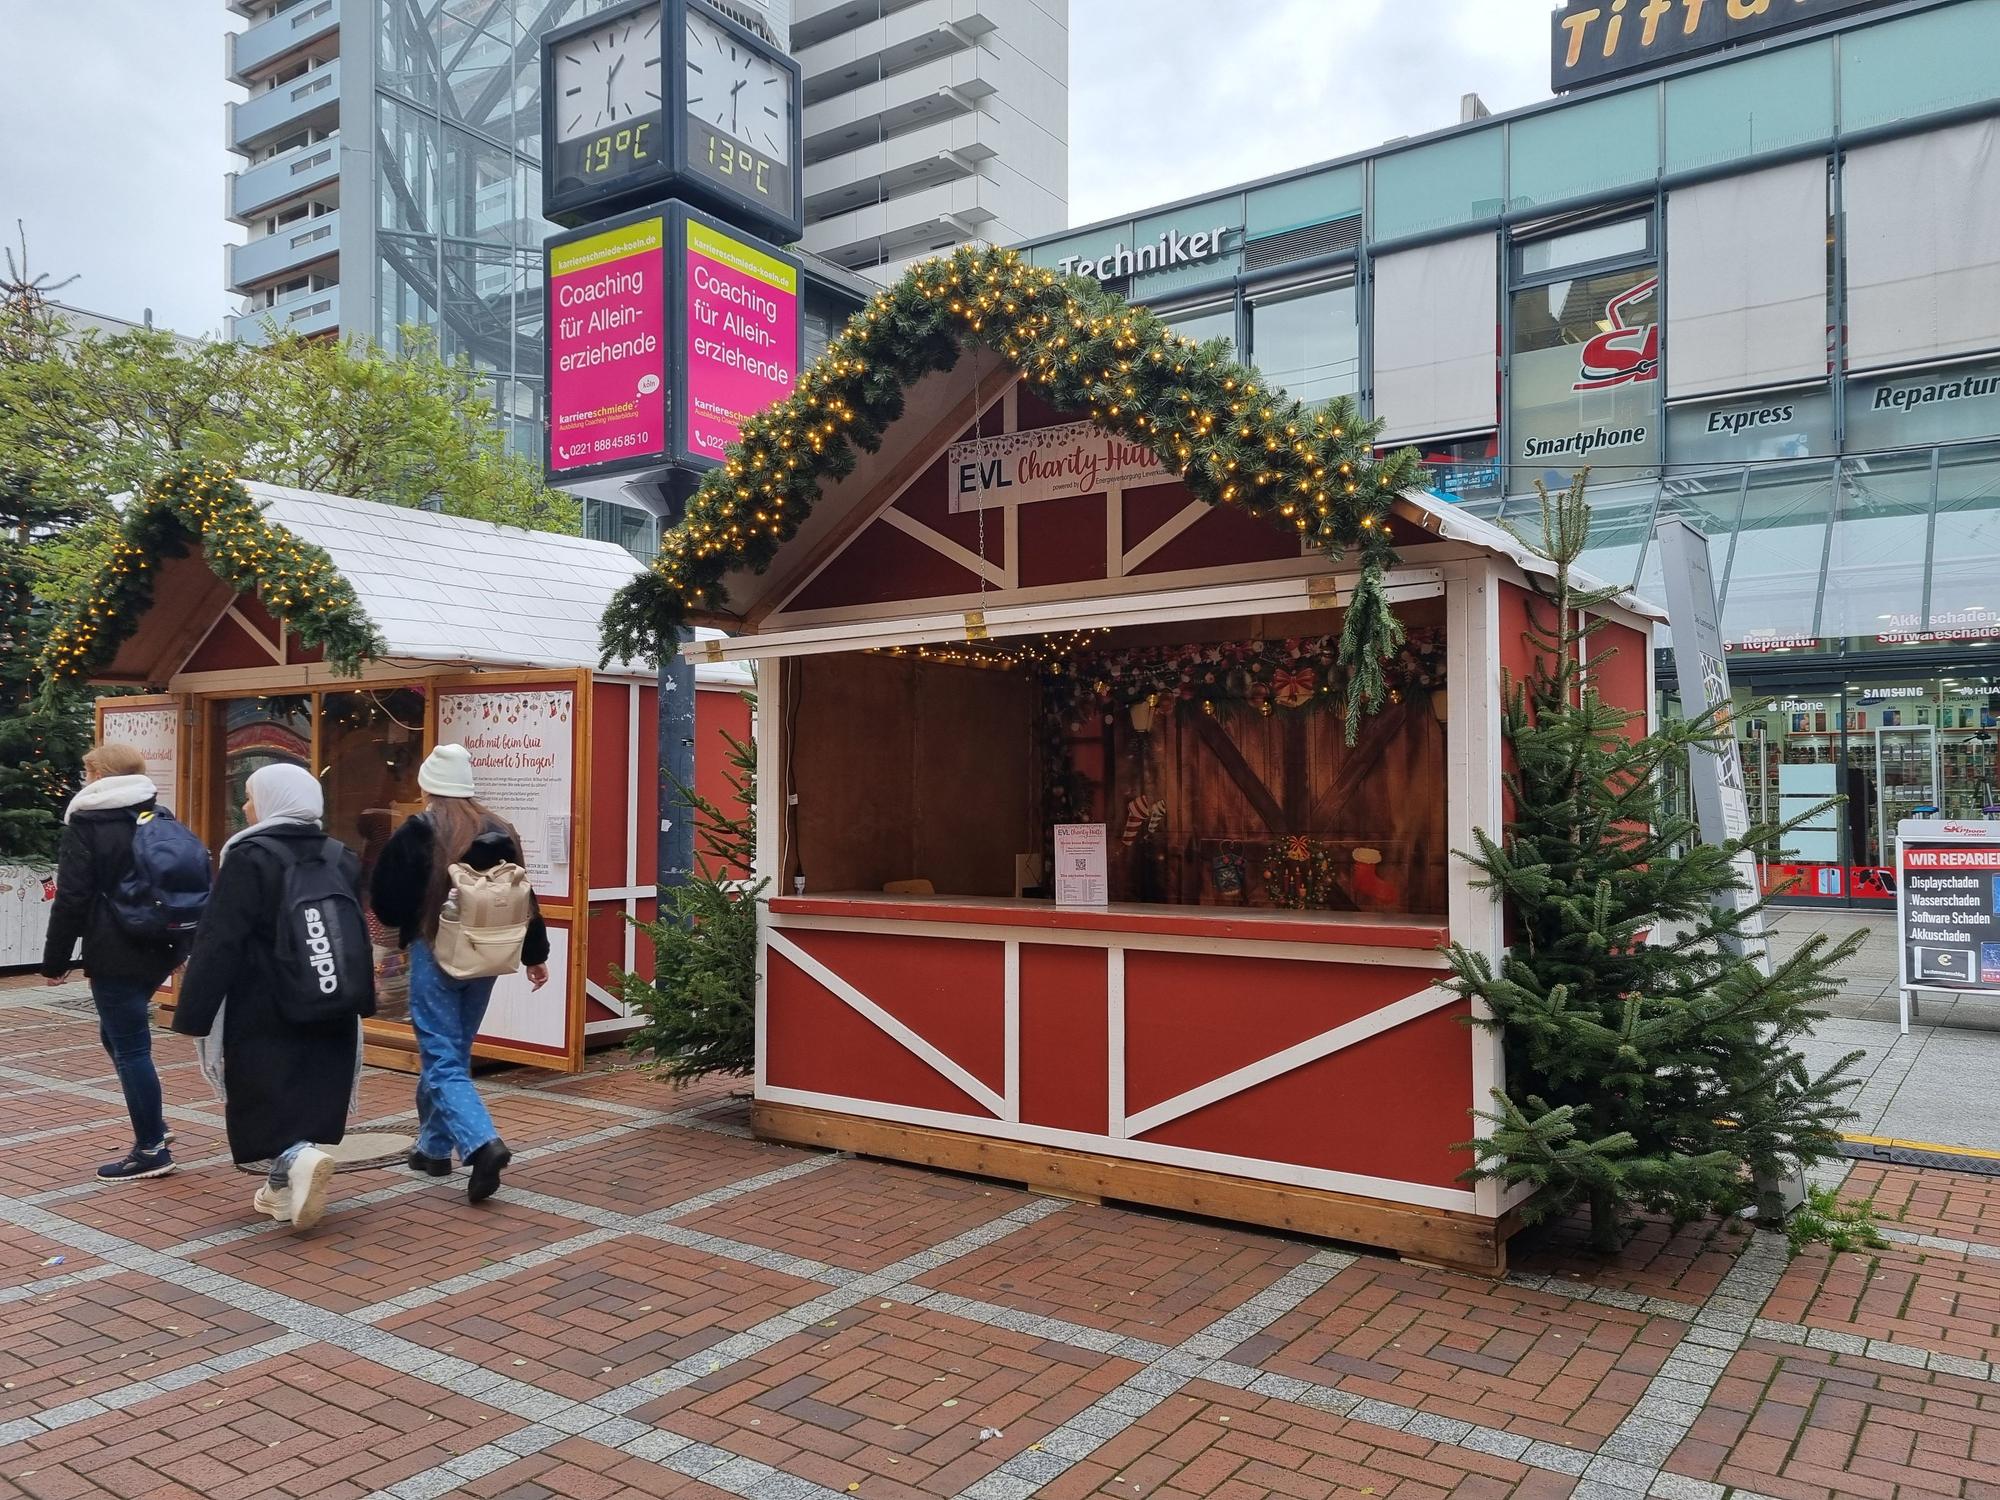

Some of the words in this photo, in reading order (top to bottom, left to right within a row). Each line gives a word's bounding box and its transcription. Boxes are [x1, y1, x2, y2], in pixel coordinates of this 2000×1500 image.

[558, 235, 657, 270] karriereschmiede-koeln.de
[694, 236, 790, 288] karriereschmiede-koeln.de
[1058, 226, 1228, 281] Techniker
[560, 271, 643, 308] Coaching
[694, 266, 777, 323] Coaching
[559, 316, 584, 340] für
[588, 304, 643, 334] Allein-
[694, 298, 719, 327] für
[723, 311, 777, 347] Allein-
[560, 332, 656, 372] erziehende
[694, 337, 788, 385] erziehende
[1874, 376, 2000, 411] Reparatur
[559, 402, 634, 424] karriereschmiede
[694, 397, 755, 422] karriereschm
[1707, 405, 1793, 434] Express
[570, 442, 591, 457] 0221
[706, 434, 728, 451] 022
[1523, 427, 1646, 456] Smartphone
[960, 459, 1013, 493] EVL
[1018, 439, 1162, 493] Charity-Hütt
[1889, 611, 1997, 627] Akkschaden
[1877, 626, 2000, 643] Softwareschade
[1863, 687, 1924, 698] SAMSUNG
[1974, 686, 2000, 695] HUA
[1781, 701, 1824, 712] iPhone
[464, 733, 485, 749] Mach
[486, 735, 501, 750] mit
[523, 733, 542, 749] Quiz
[515, 752, 521, 769] 3
[522, 753, 556, 775] Fragen!
[1908, 853, 1937, 866] WIR
[1952, 911, 1990, 925] Schaden
[304, 908, 338, 994] adidas
